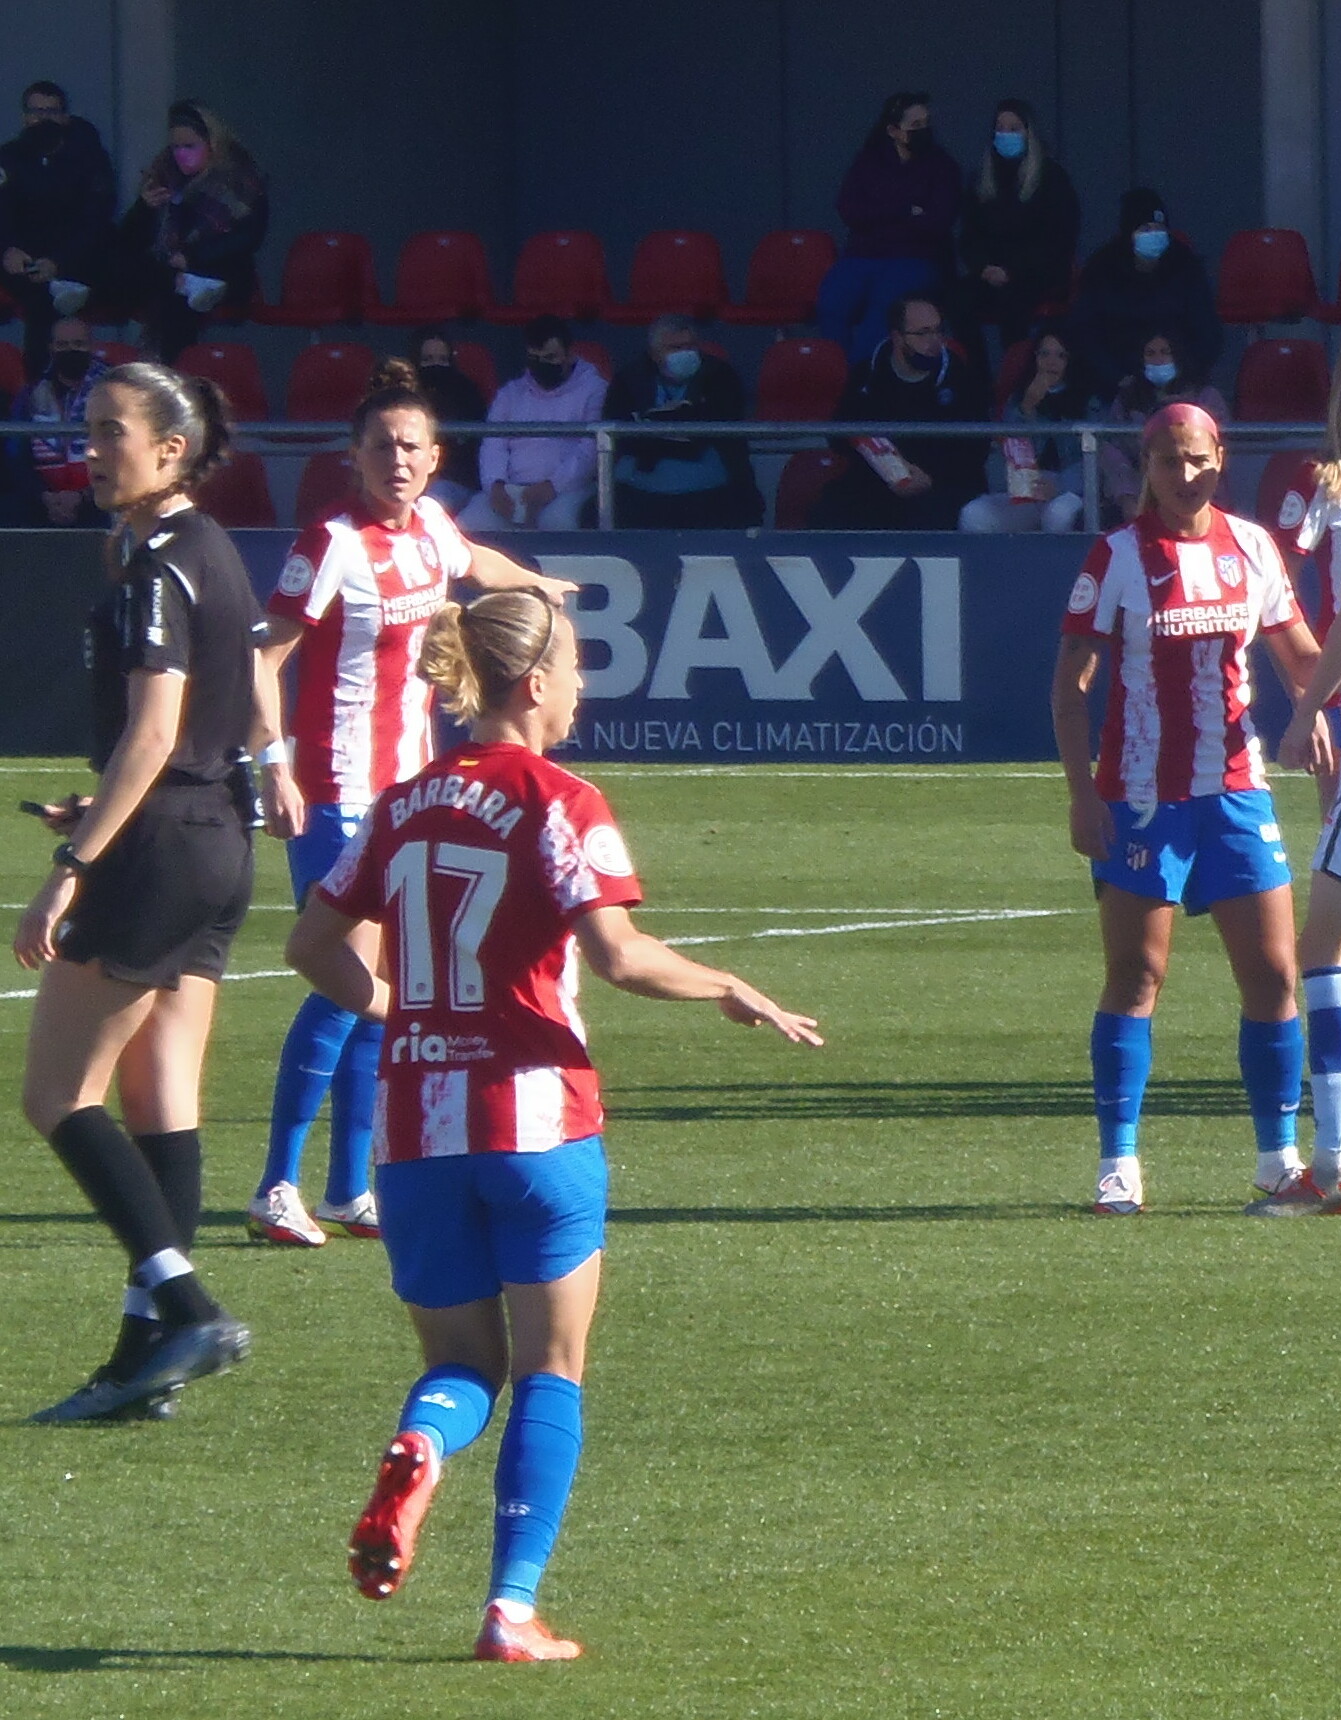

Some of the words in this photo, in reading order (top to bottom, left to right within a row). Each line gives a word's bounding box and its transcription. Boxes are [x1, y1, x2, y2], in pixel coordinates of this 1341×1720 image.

[533, 555, 962, 702] BAXI
[1154, 602, 1249, 624] HERBALIFE
[1154, 617, 1249, 637] NUTRITION
[594, 720, 703, 752] NUEVA
[713, 715, 963, 753] CLIMATIZACIÓN
[384, 840, 509, 1012] 17
[391, 1022, 447, 1063] ria
